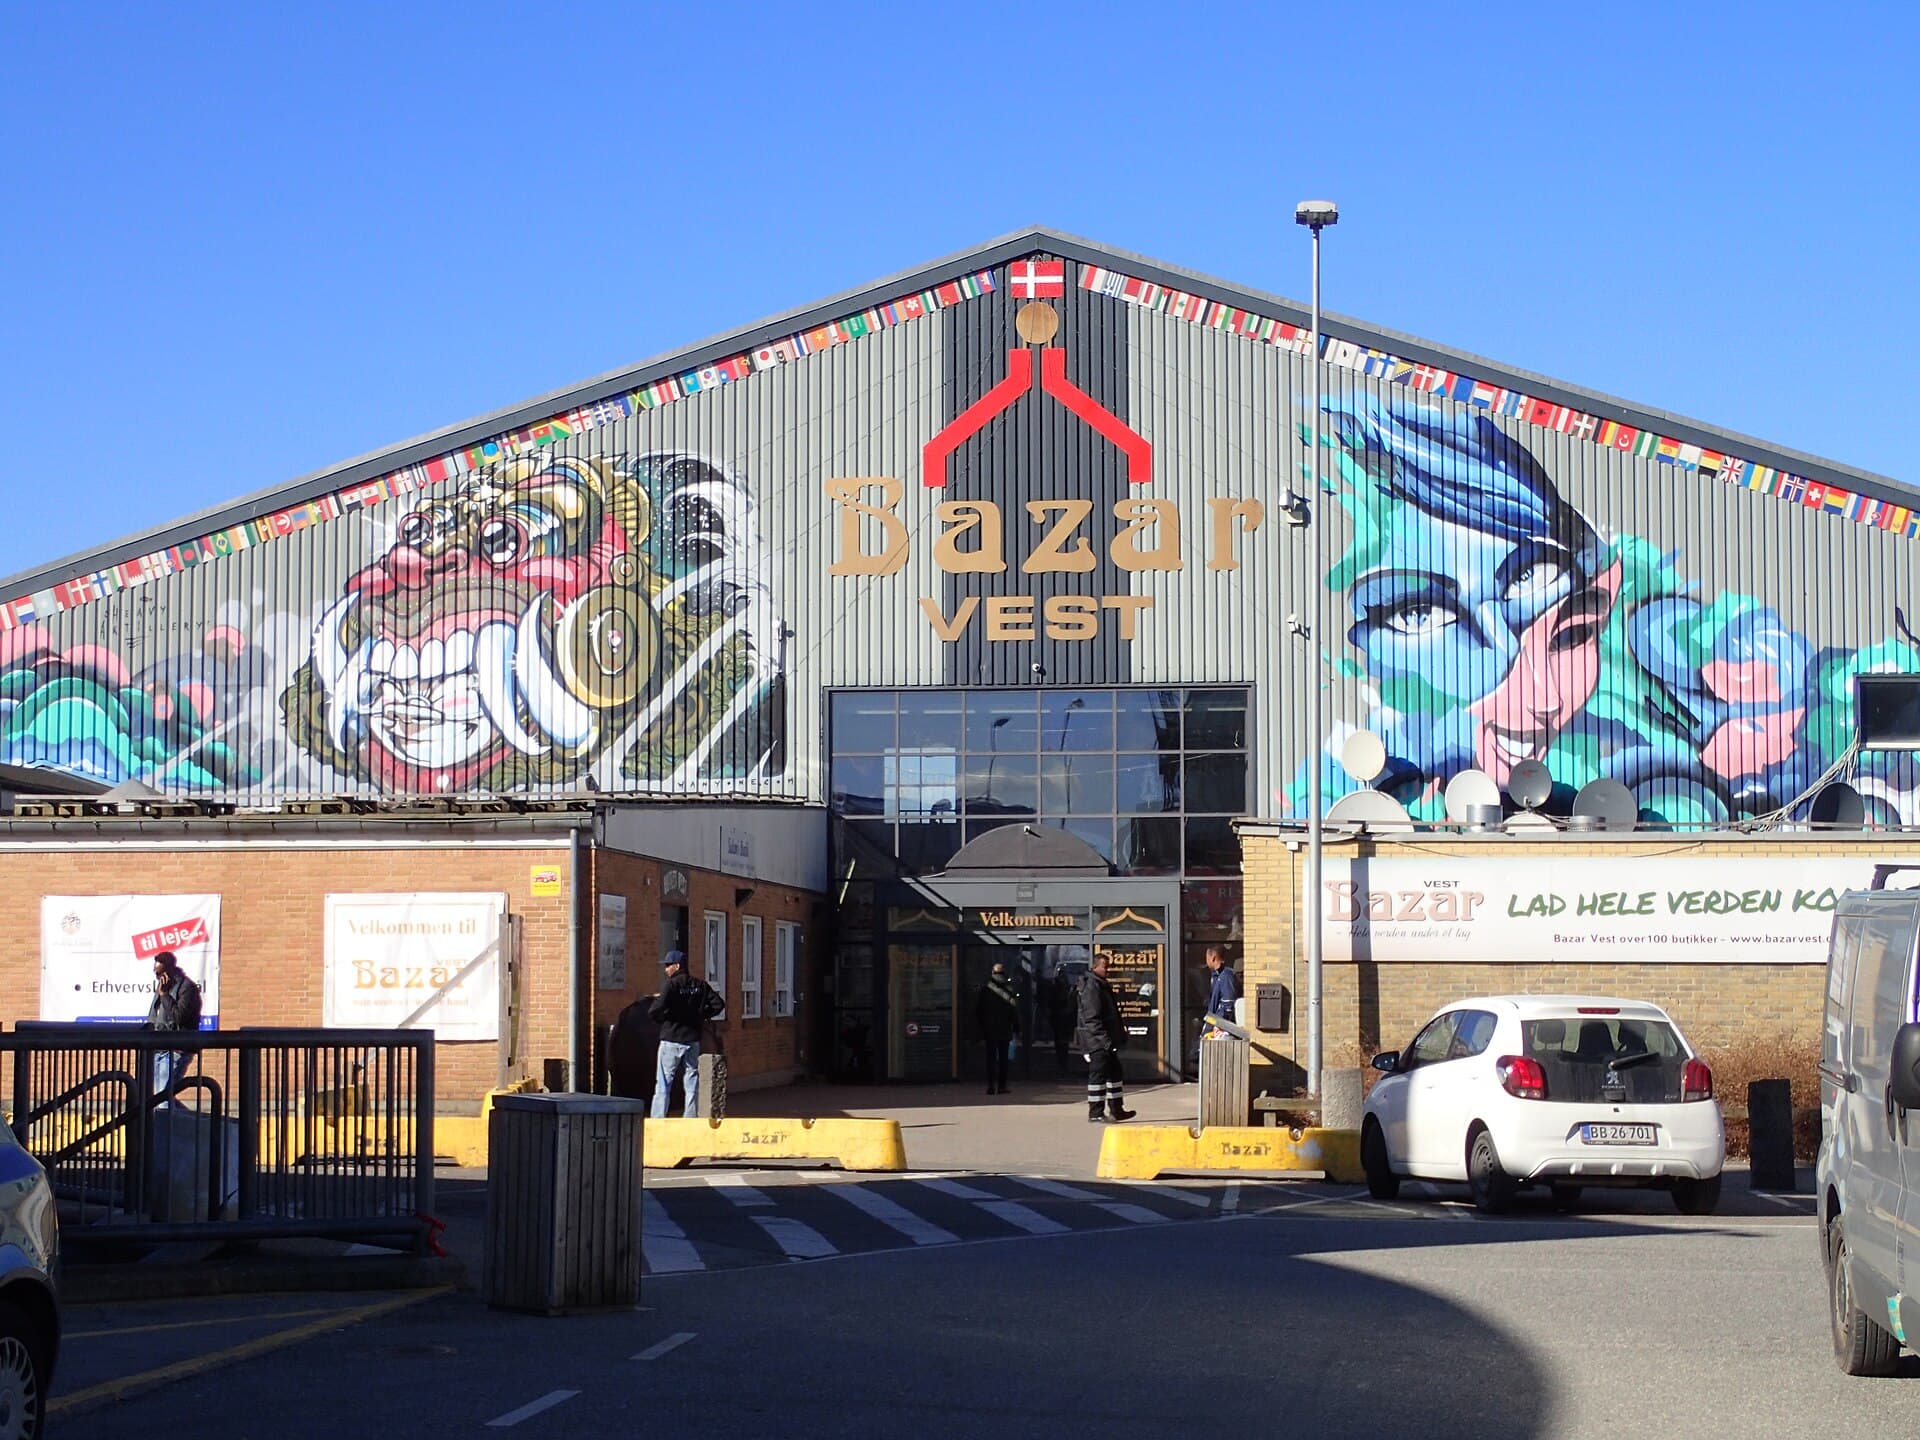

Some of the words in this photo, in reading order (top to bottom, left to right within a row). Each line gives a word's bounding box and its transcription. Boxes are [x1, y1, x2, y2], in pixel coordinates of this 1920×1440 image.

[824, 477, 1265, 577] Bazar
[918, 595, 1154, 642] VEST
[1424, 880, 1461, 888] VEST
[1324, 880, 1485, 922] Bazar
[1508, 893, 1567, 918] LAD
[1577, 891, 1657, 916] HELE
[1667, 888, 1783, 915] VERDEN
[1791, 887, 1839, 912] KO
[348, 919, 452, 935] Velkommen
[458, 918, 477, 934] til
[980, 911, 1074, 927] Velkommen
[141, 933, 158, 951] til
[1554, 934, 1586, 943] Bazar
[1591, 934, 1616, 944] Vest
[352, 959, 466, 990] Bazar
[1590, 1126, 1607, 1138] BB
